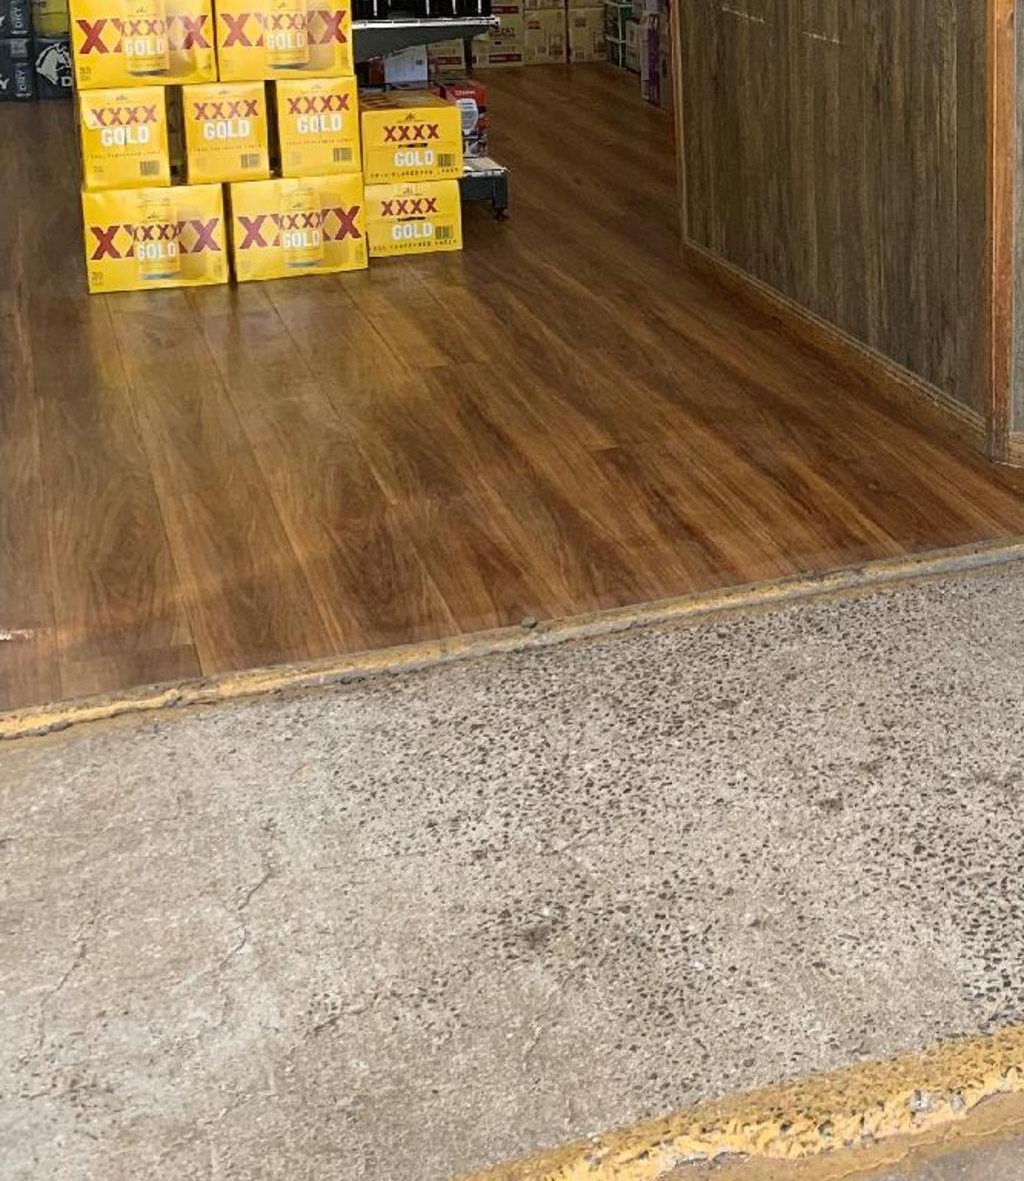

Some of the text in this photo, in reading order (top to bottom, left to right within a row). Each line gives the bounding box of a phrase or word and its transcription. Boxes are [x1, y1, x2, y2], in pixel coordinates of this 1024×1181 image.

[125, 37, 165, 56] GOLD
[193, 99, 259, 120] XXXX
[287, 93, 350, 115] XXXX
[91, 104, 158, 127] XXXX
[297, 113, 343, 134] GOLD
[101, 125, 149, 147] GOLD
[203, 119, 250, 141] GOLD
[383, 123, 440, 142] XXXX
[394, 150, 435, 167] GOLD
[381, 197, 439, 217] XXXX
[283, 230, 320, 249] GOLD
[392, 222, 432, 240] GOLD
[137, 242, 176, 260] GOLD
